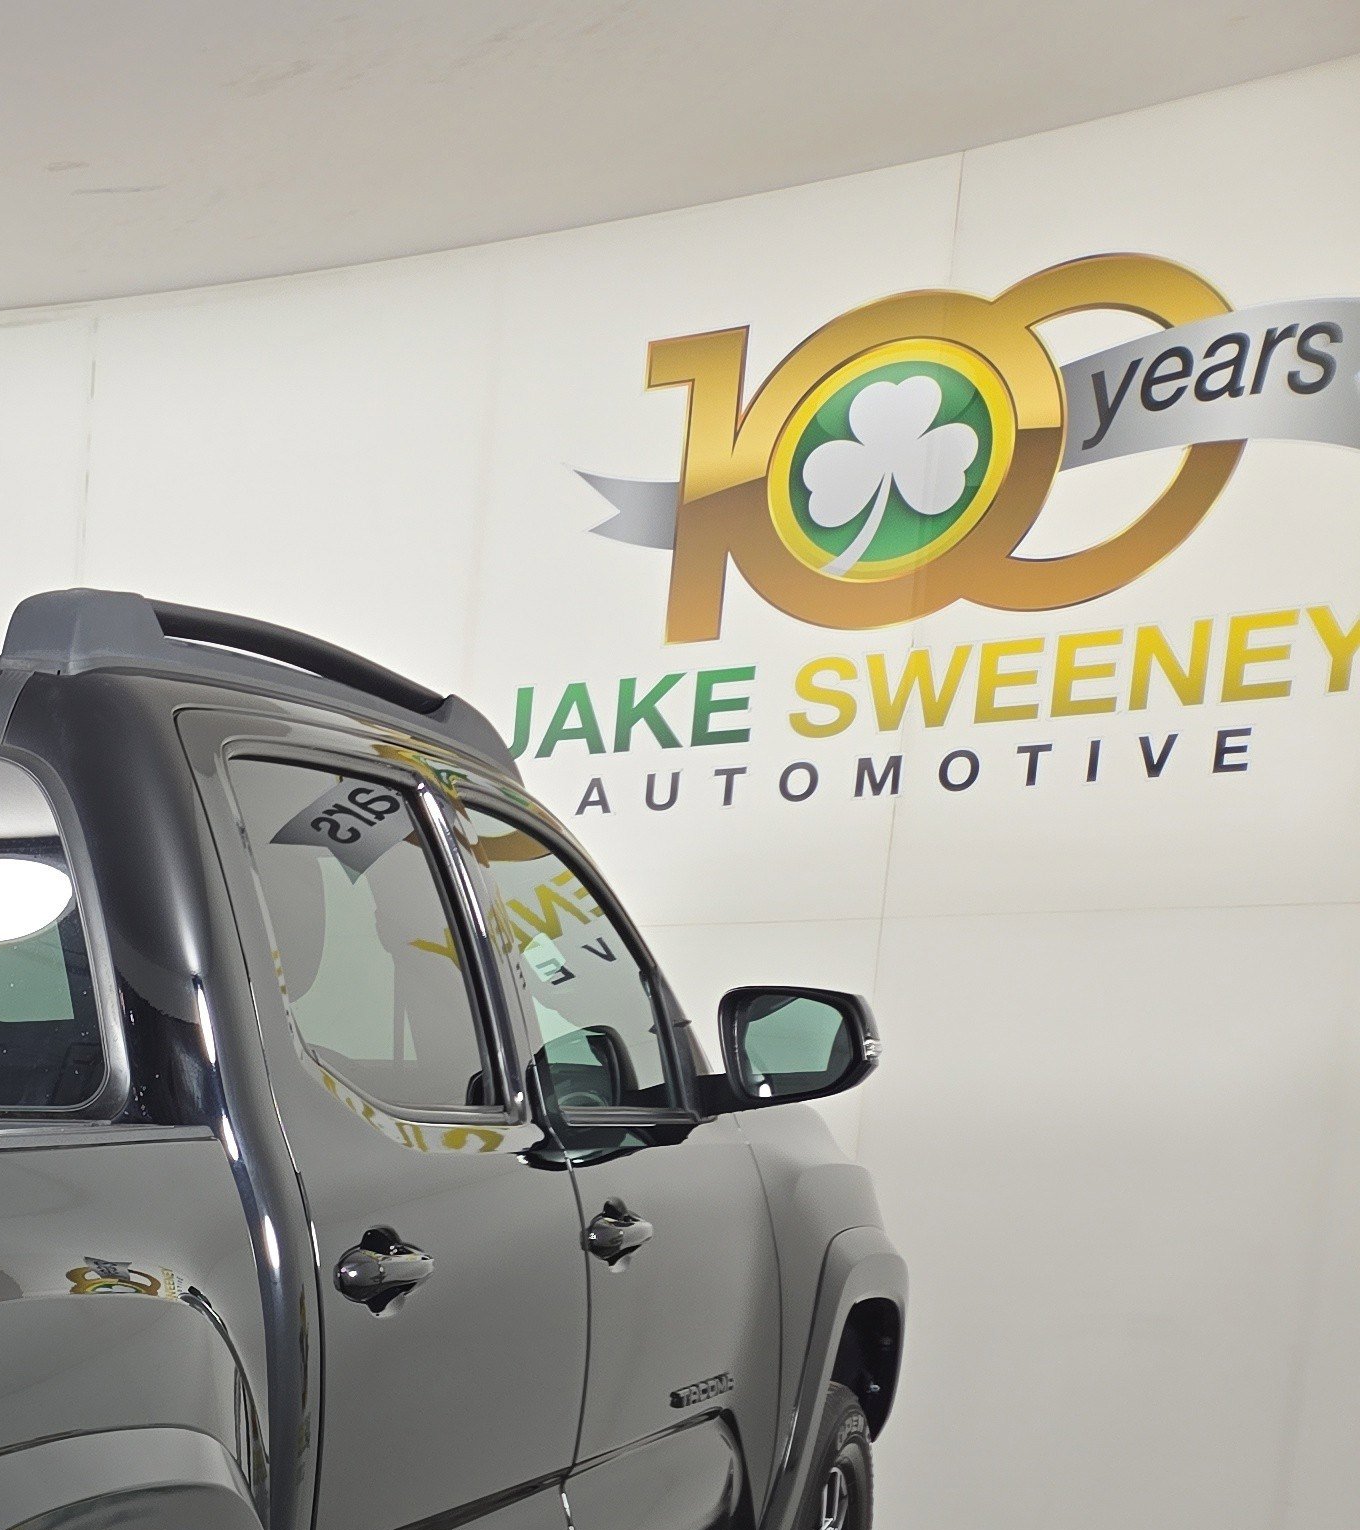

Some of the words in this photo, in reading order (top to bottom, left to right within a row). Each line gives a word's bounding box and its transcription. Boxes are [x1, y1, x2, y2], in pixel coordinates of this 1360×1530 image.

[1081, 320, 1344, 451] years
[508, 665, 757, 760] JAKE
[788, 605, 1360, 738] SWEENEY
[574, 727, 1253, 818] AUTOMOTIVE
